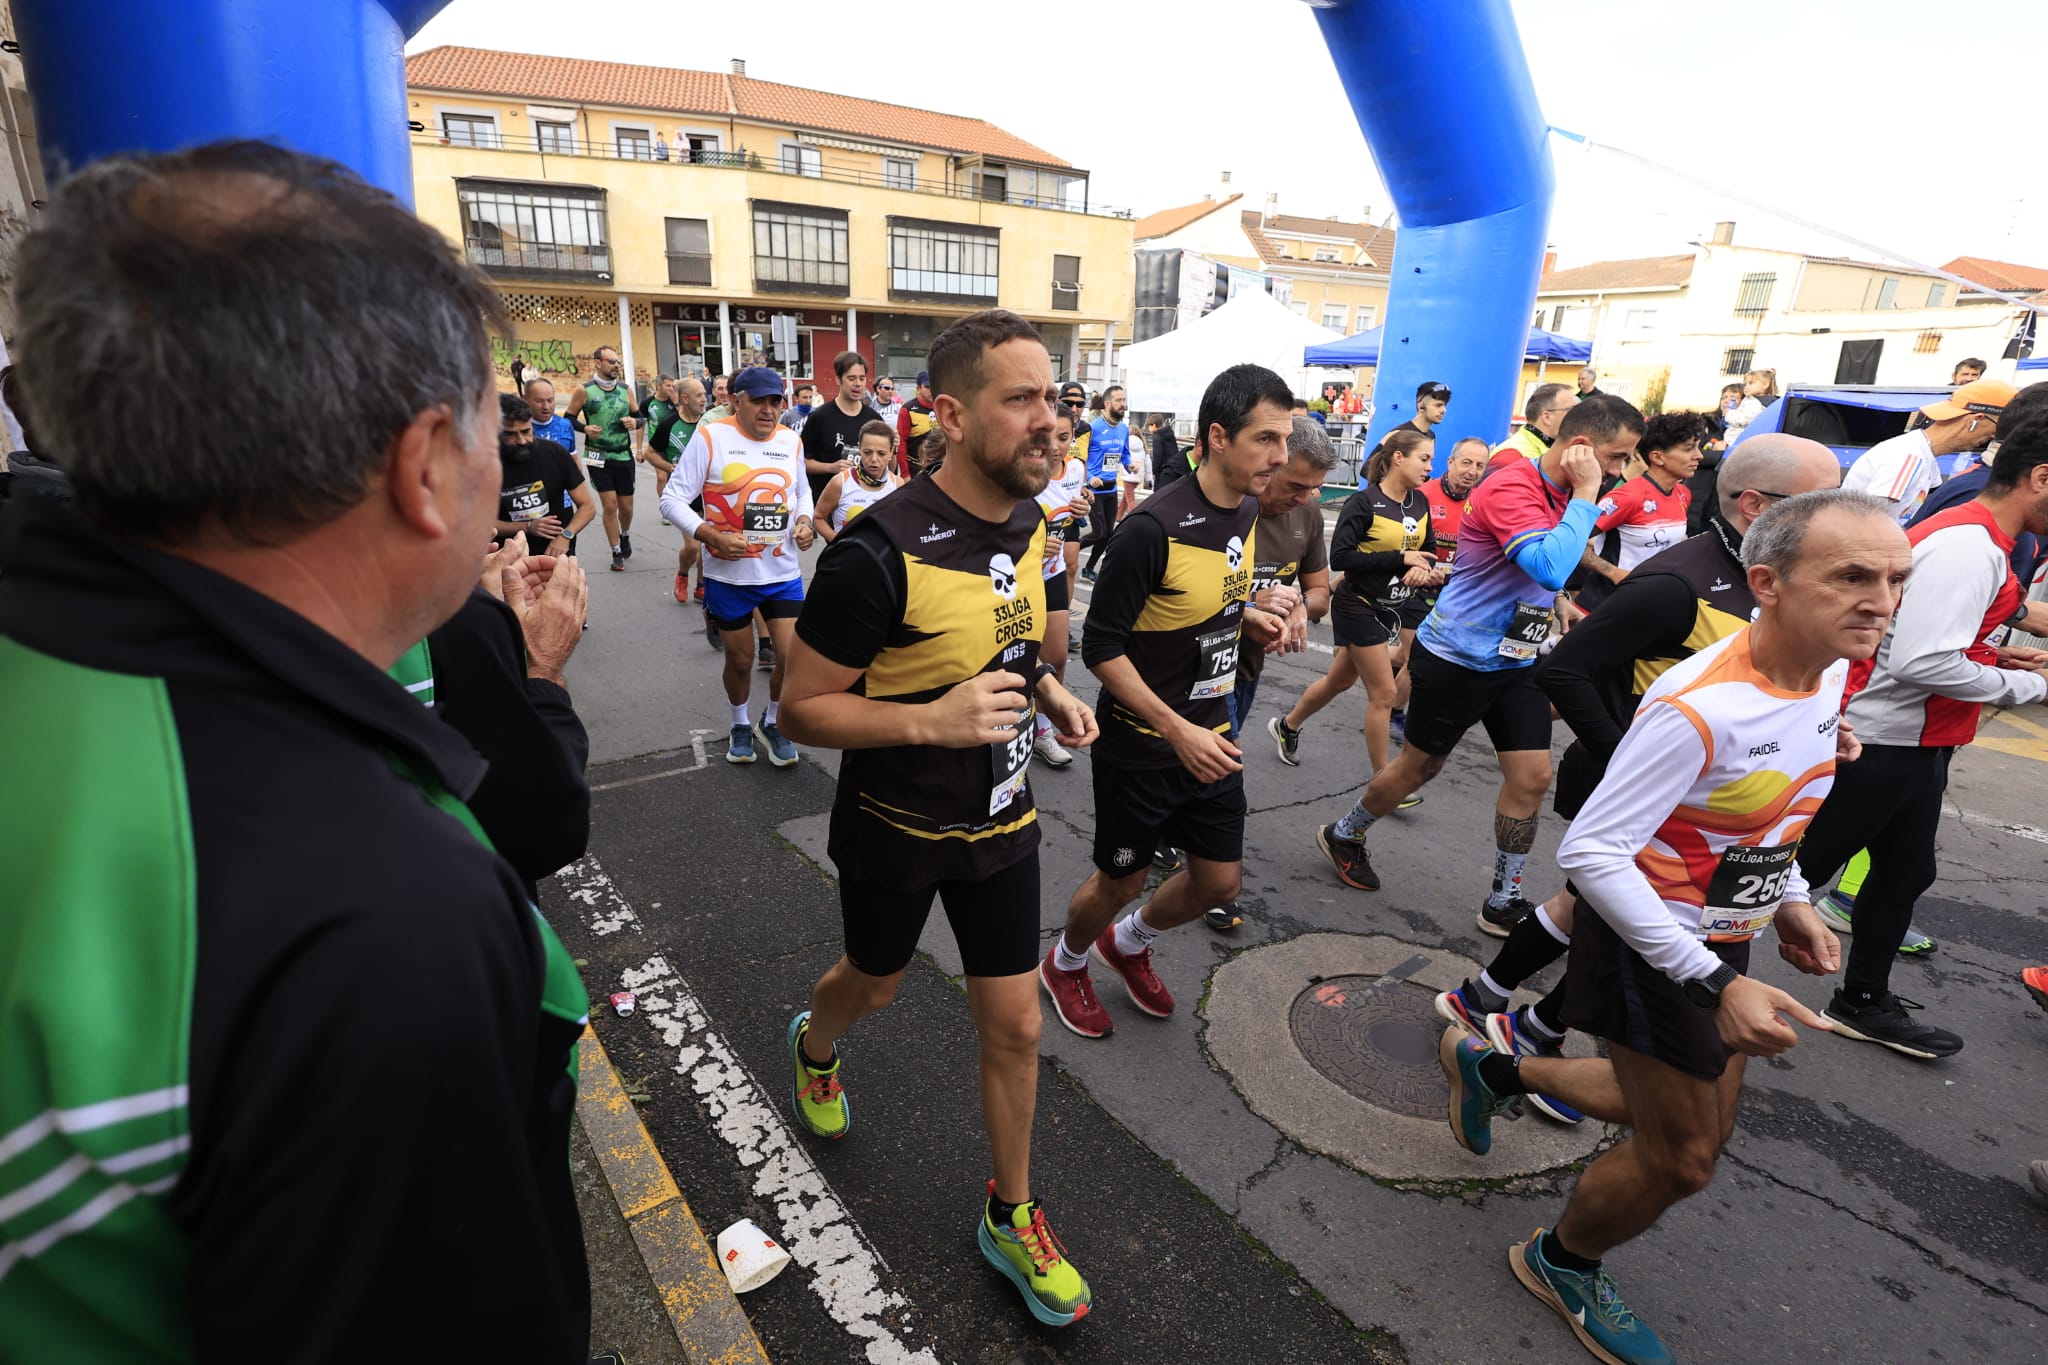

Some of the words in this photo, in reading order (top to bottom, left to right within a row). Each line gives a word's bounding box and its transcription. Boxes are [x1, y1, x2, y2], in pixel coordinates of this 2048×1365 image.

[588, 451, 600, 460] 101
[512, 493, 541, 510] 435
[753, 515, 782, 530] 253
[1222, 583, 1248, 603] CROSS
[995, 617, 1033, 644] CROSS
[1521, 622, 1548, 642] 412
[1002, 644, 1019, 664] AVS
[1211, 644, 1239, 675] 754
[1007, 720, 1035, 772] 333
[1748, 741, 1781, 759] FAIDEL
[1726, 852, 1741, 862] 33
[1741, 854, 1763, 864] LIGA
[1732, 867, 1791, 904] 256
